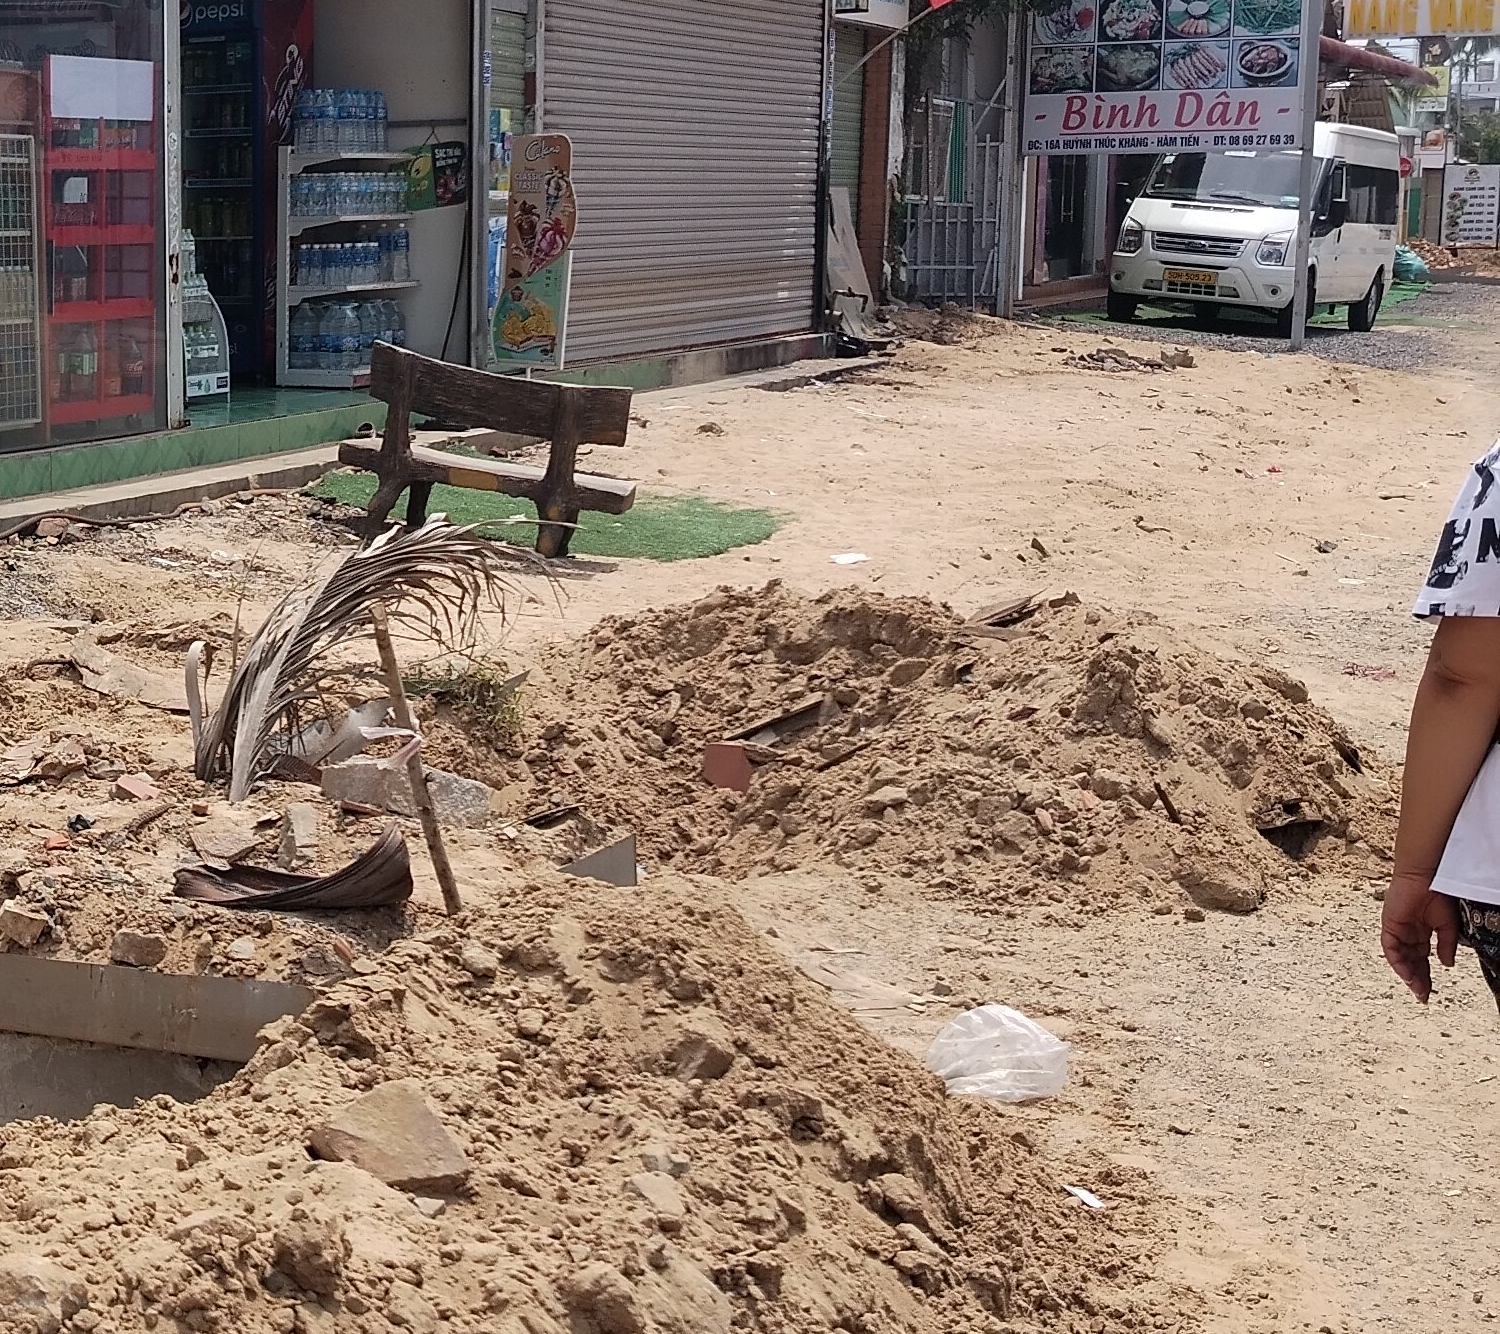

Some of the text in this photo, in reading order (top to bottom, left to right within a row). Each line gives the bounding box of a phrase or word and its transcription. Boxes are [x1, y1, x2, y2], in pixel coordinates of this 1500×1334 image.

[195, 0, 244, 24] pepsi
[1061, 90, 1160, 132] Bình
[1173, 88, 1260, 128] Dân
[1255, 135, 1267, 145] 27
